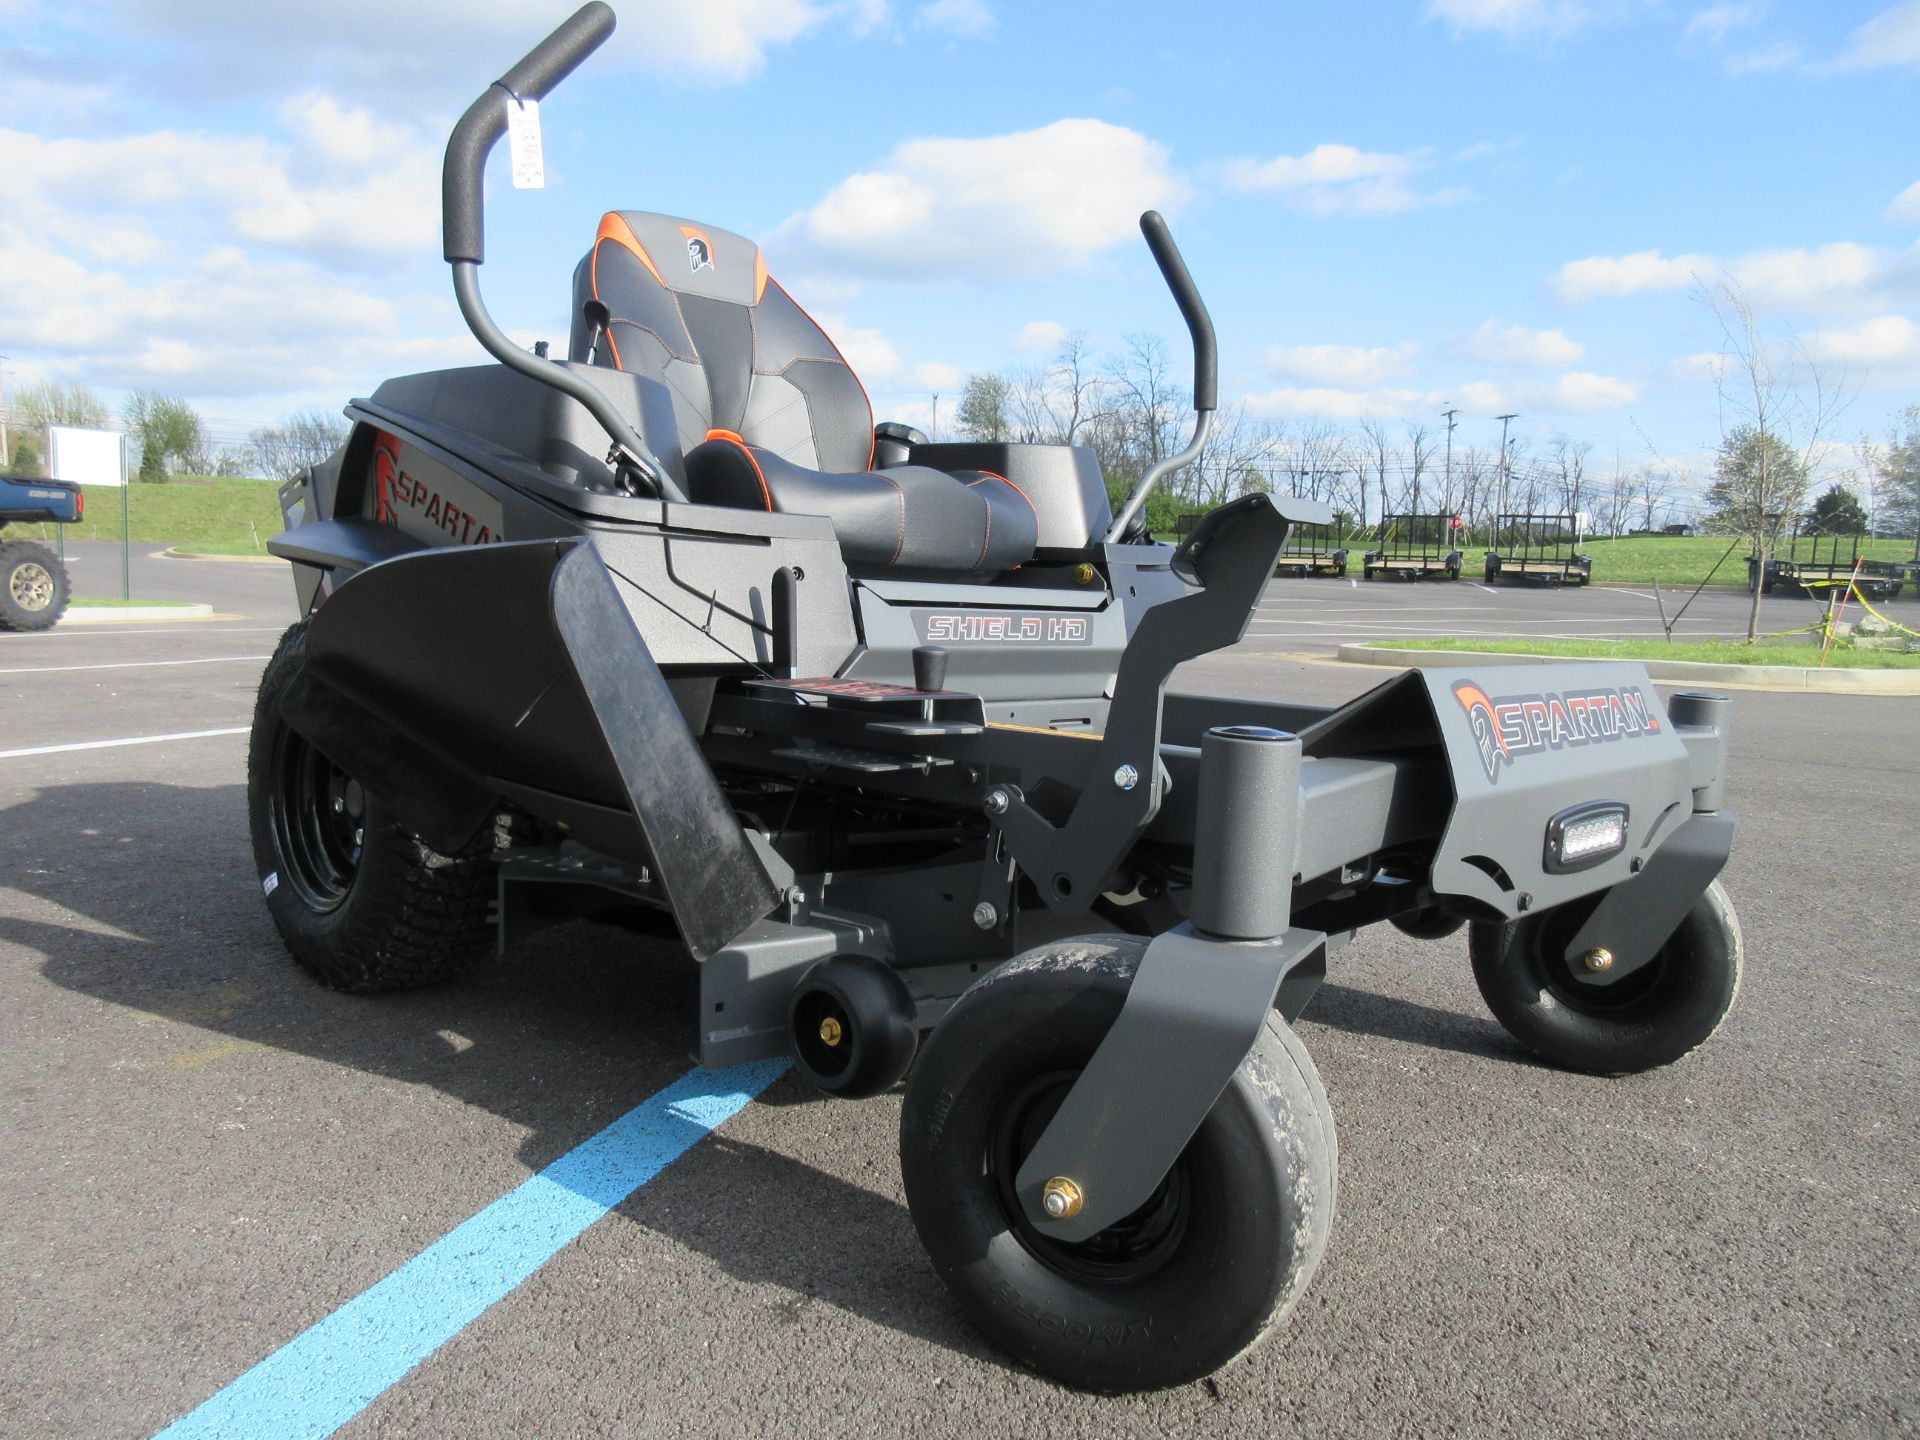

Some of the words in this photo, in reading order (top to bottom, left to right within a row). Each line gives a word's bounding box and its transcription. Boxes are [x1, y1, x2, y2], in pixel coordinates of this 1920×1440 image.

[395, 470, 502, 545] SPARTA
[927, 616, 1042, 641] SHIELD
[1047, 618, 1088, 641] HD
